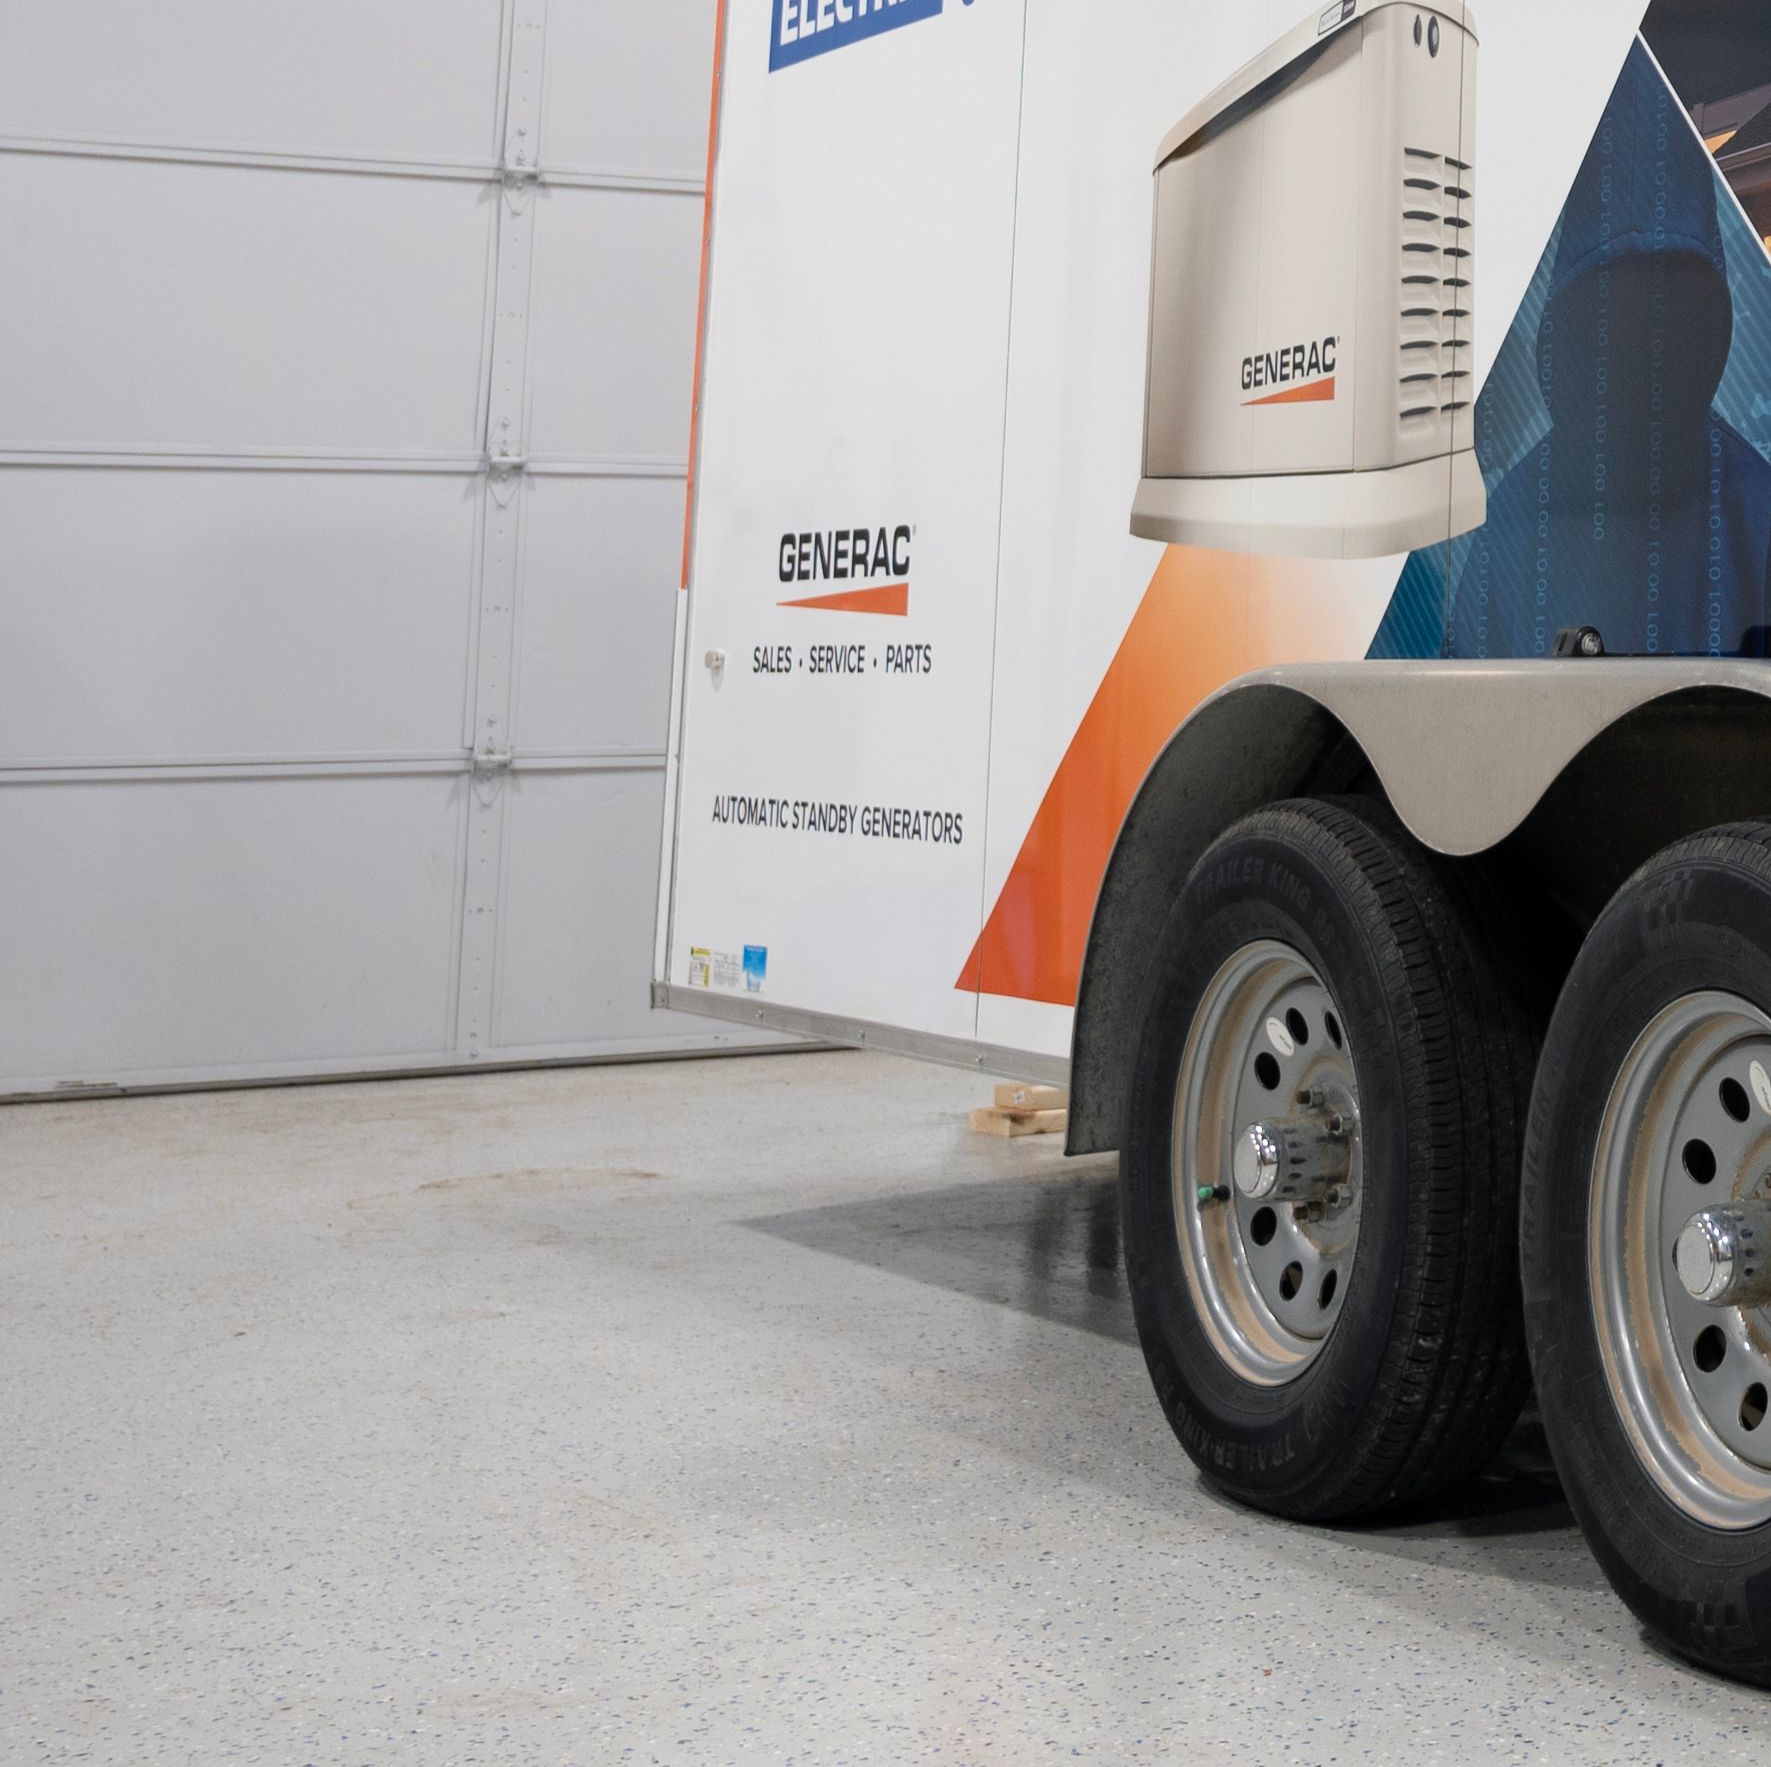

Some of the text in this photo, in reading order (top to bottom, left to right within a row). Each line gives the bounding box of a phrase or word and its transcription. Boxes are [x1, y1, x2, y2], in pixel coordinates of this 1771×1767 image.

[752, 643, 933, 675] SALES SERVICE PARTS
[712, 794, 964, 845] AUTOMATIC STANDBY GENERATORS
